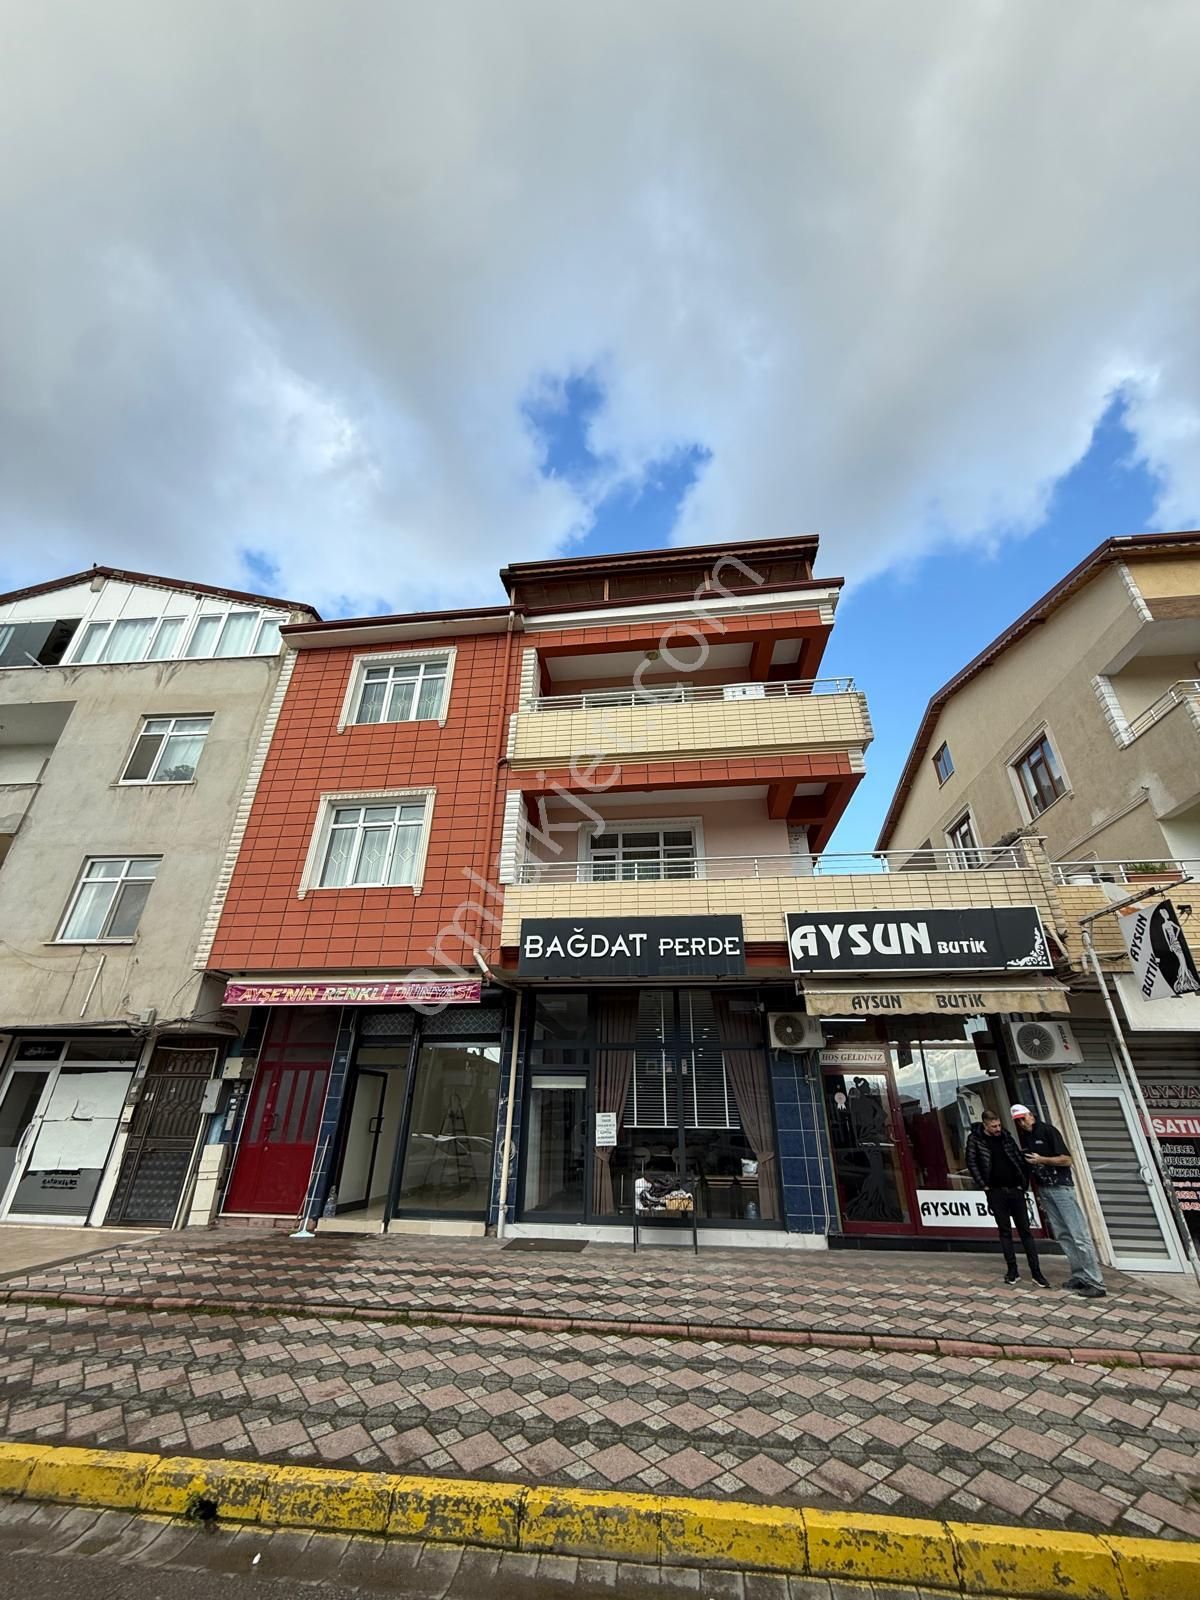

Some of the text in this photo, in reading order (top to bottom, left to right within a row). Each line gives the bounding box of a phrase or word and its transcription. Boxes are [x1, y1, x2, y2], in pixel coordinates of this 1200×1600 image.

[524, 928, 741, 959] BAĞDAT PERDE
[790, 921, 988, 960] AYSUN BUTİK
[1129, 913, 1160, 998] AYSUN BUTİK
[238, 985, 318, 1004] AYŞE'NİN
[321, 985, 389, 1002] RENKLİ
[851, 994, 987, 1011] AYSUN BUTİK
[822, 1053, 839, 1063] HOŞ
[1160, 1143, 1195, 1155] AİRELER
[920, 1201, 972, 1218] AYSUN
